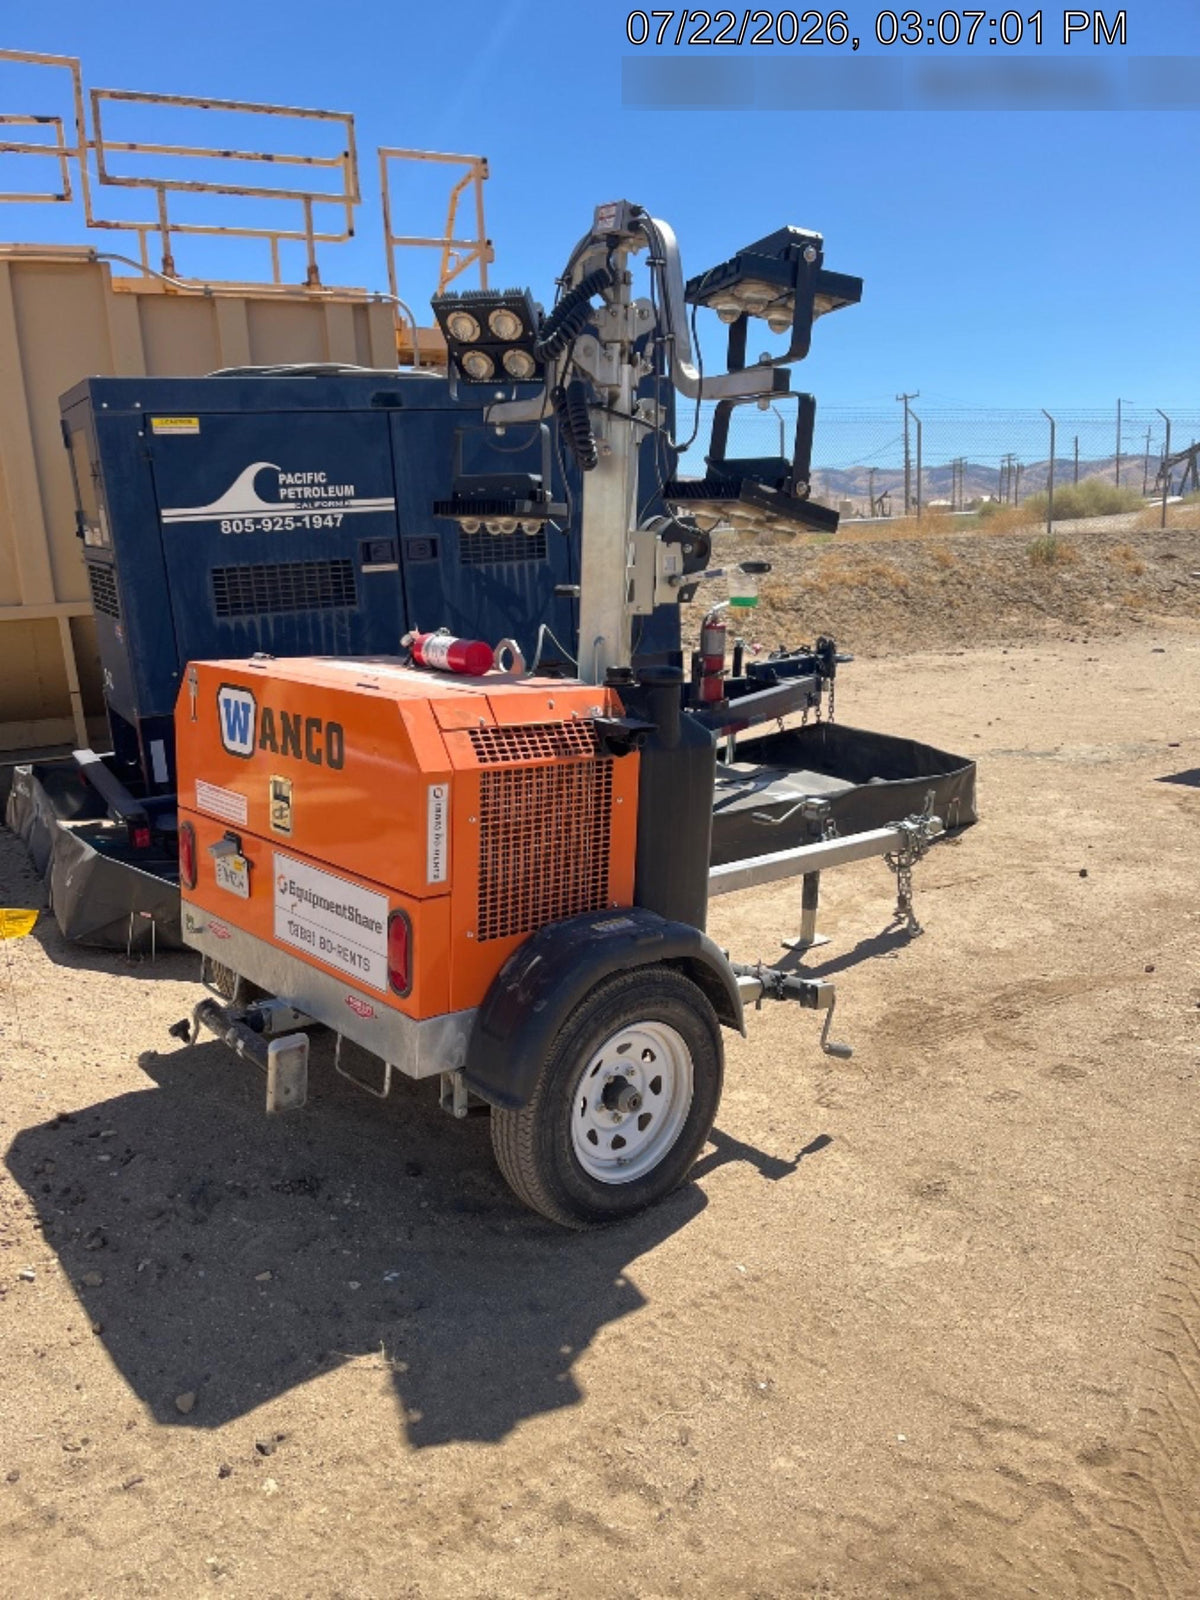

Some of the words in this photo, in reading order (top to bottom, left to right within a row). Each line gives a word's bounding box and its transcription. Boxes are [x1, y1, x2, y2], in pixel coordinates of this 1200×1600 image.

[278, 472, 327, 485] PACIFIC
[279, 485, 355, 500] PETROLEUM
[220, 514, 344, 534] 805-925-1947
[220, 692, 345, 771] WANCO
[288, 880, 383, 935] EquipmentShare
